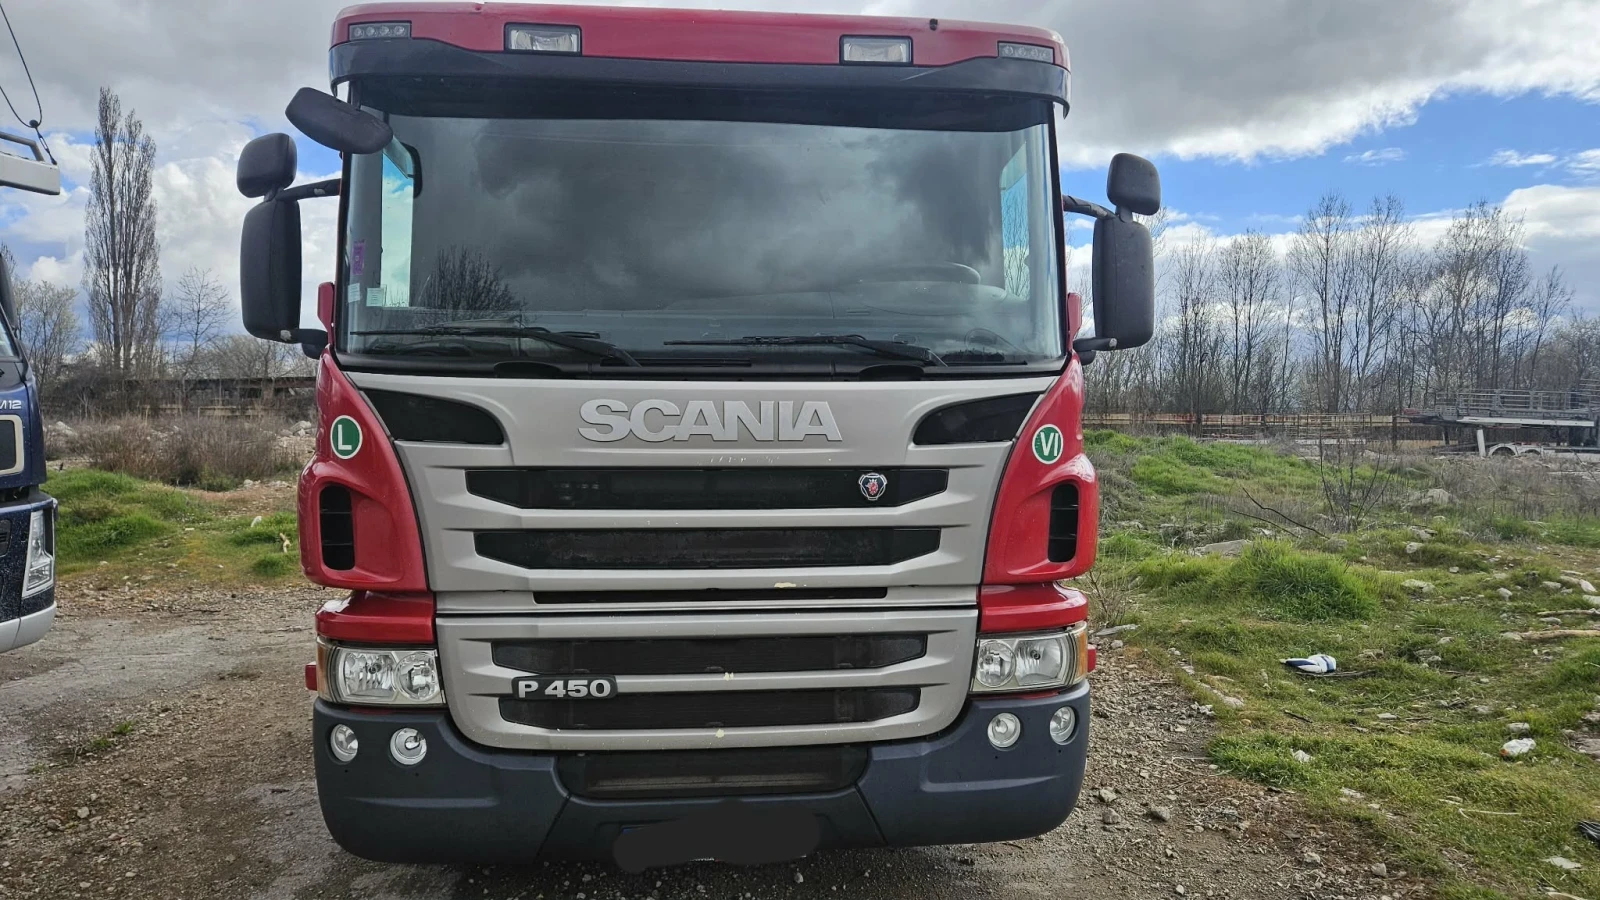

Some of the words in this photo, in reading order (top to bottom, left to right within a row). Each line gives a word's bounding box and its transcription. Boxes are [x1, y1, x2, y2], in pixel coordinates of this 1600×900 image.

[578, 398, 843, 443] SCANIA
[337, 424, 353, 451] L
[1040, 431, 1059, 457] VI
[518, 680, 539, 698] P
[544, 679, 611, 698] 450
